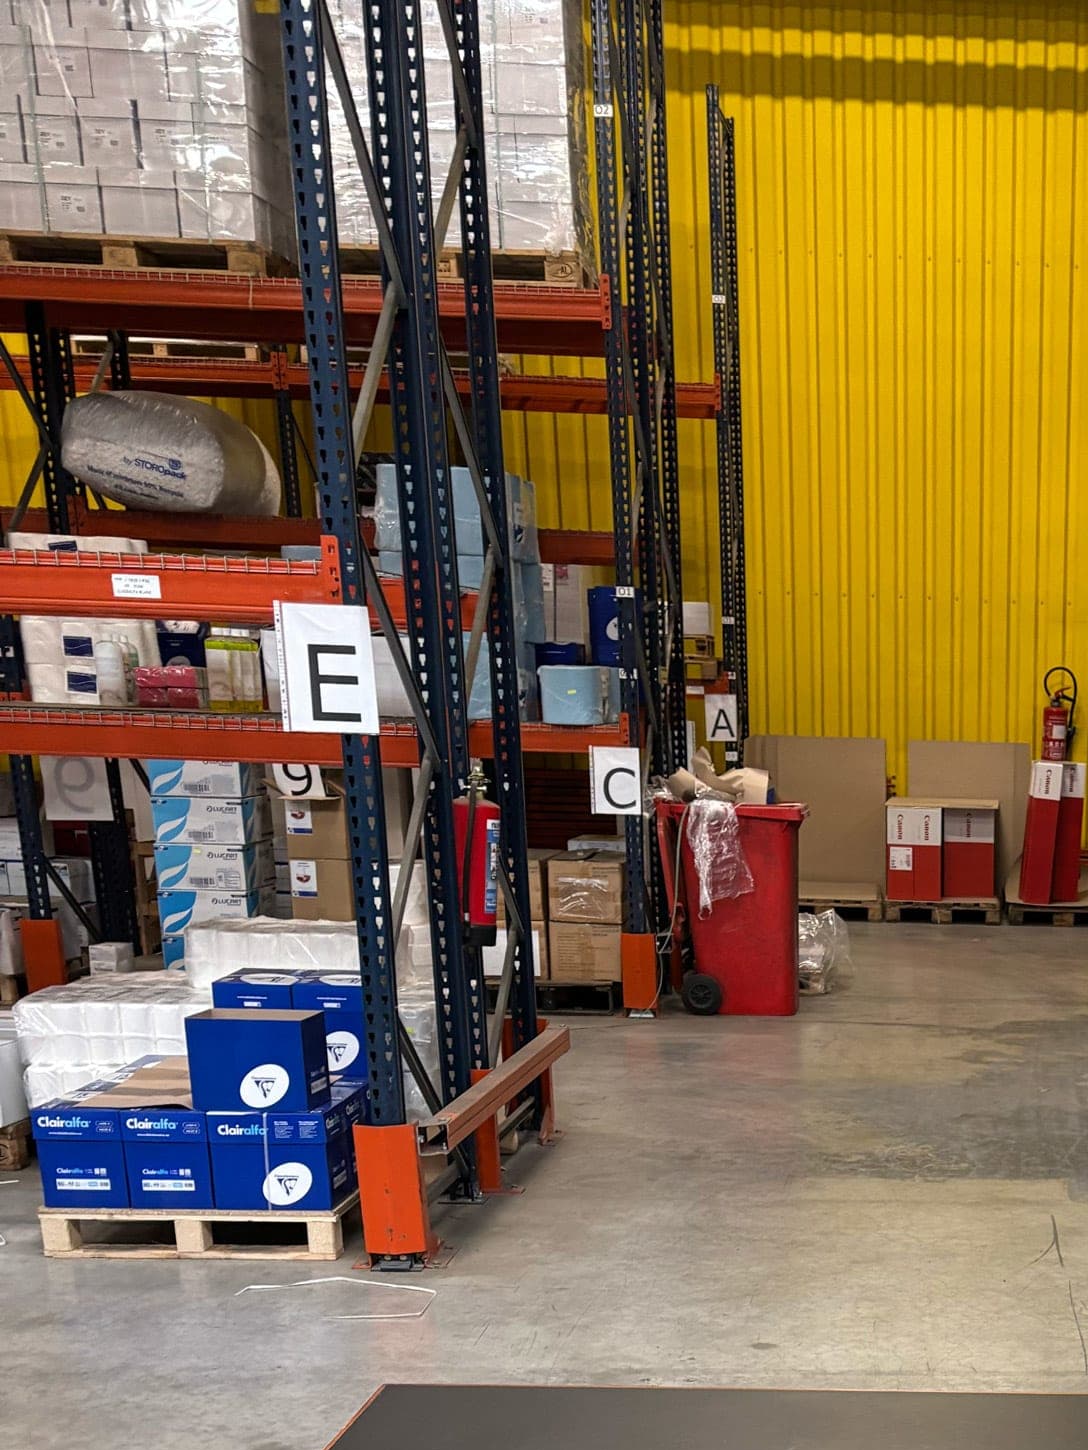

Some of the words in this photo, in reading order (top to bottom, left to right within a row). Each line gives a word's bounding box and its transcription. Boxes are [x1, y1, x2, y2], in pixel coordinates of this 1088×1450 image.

[308, 644, 362, 724] E
[711, 708, 736, 738] A
[281, 763, 313, 796] 9
[603, 767, 638, 809] C
[1045, 769, 1053, 795] Canon
[37, 1115, 90, 1129] Clairalfa
[126, 1117, 177, 1131] Clairalfa
[217, 1123, 267, 1136] Clairalfa
